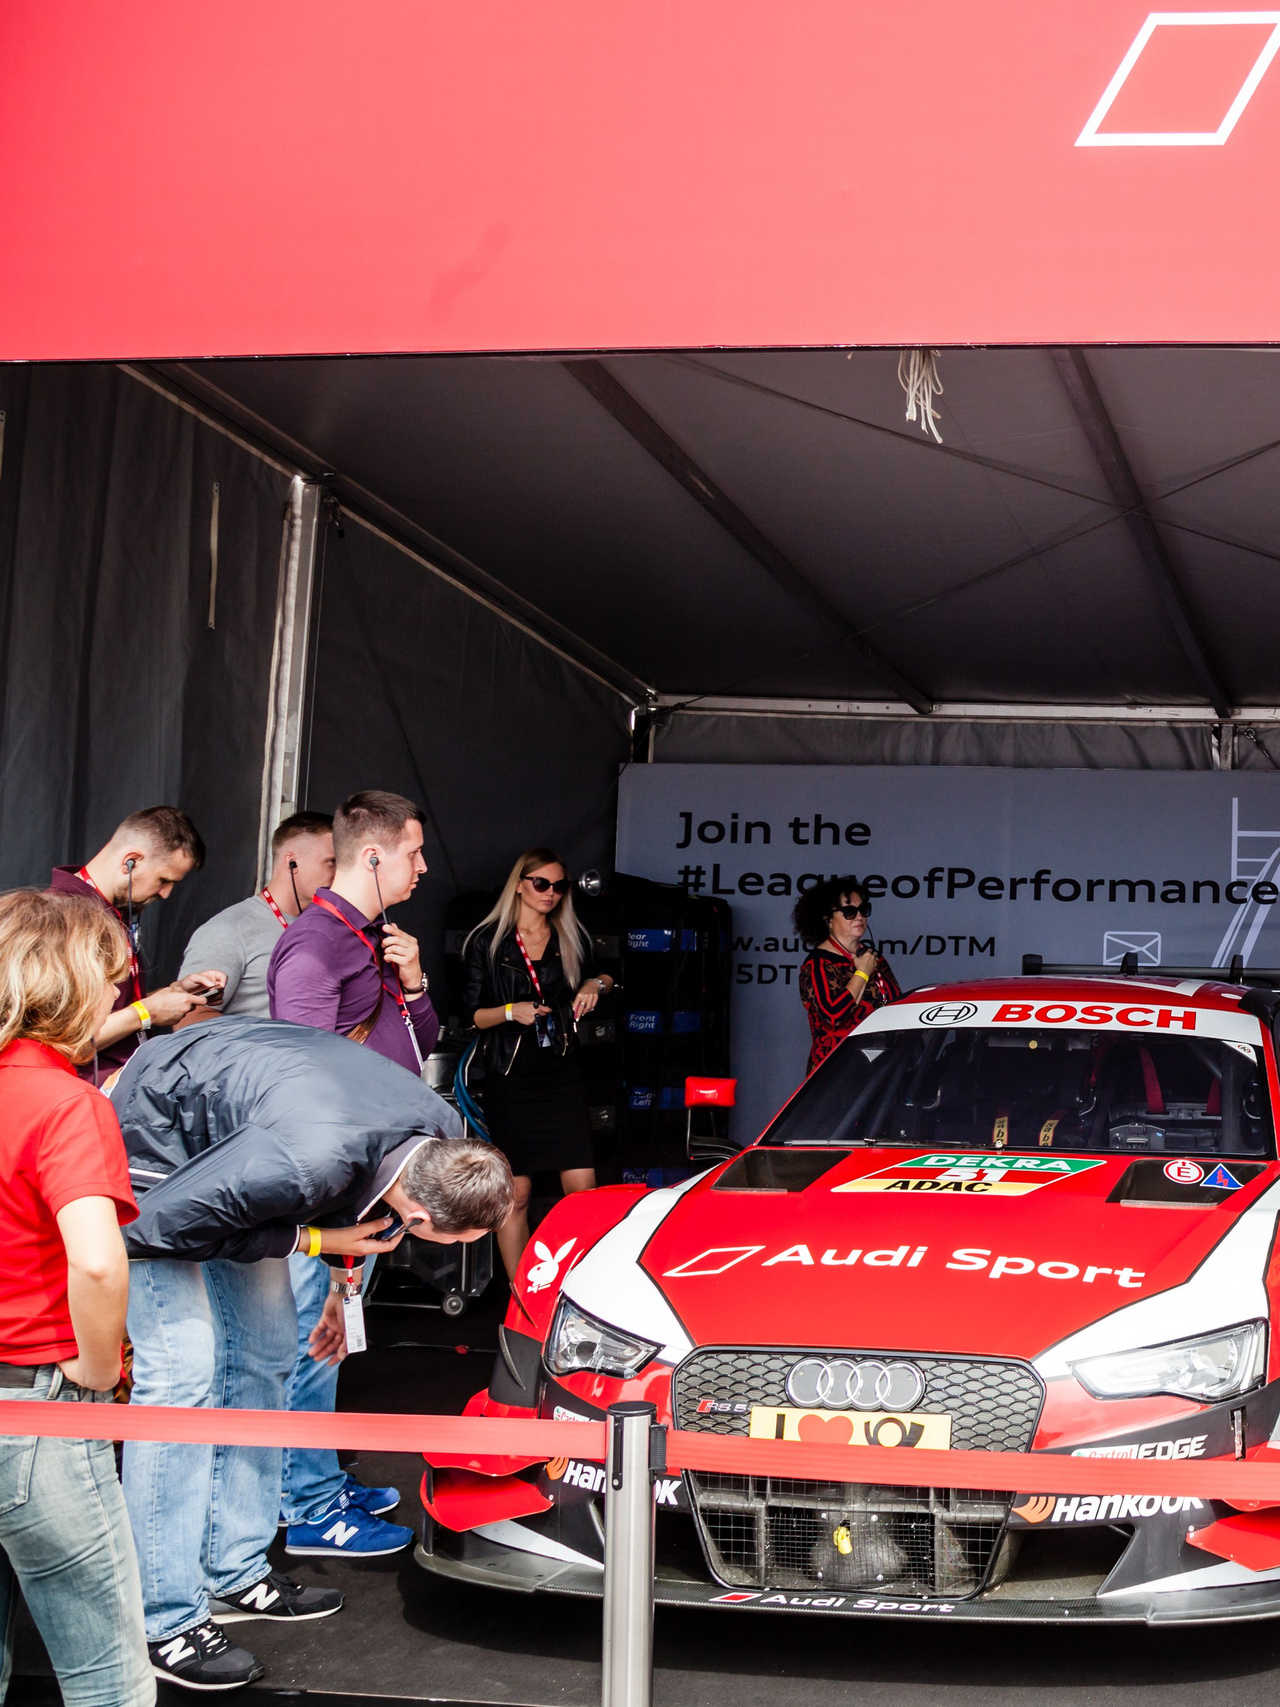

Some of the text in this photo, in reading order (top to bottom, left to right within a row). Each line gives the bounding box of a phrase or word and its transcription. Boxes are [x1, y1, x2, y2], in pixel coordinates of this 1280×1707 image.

[676, 811, 872, 849] Join the
[677, 863, 1280, 905] #LeaeofPerformance
[735, 964, 798, 985] 5DT
[629, 1014, 656, 1022] Front
[629, 1020, 655, 1030] Right
[991, 1003, 1197, 1031] BOSCH
[923, 1156, 1072, 1171] DEKRA
[935, 1168, 1009, 1182] 51
[884, 1180, 993, 1193] ADAC
[761, 1244, 1146, 1289] Audi Sport
[1138, 1434, 1208, 1461] EDGE
[759, 1594, 955, 1613] Audi Sport
